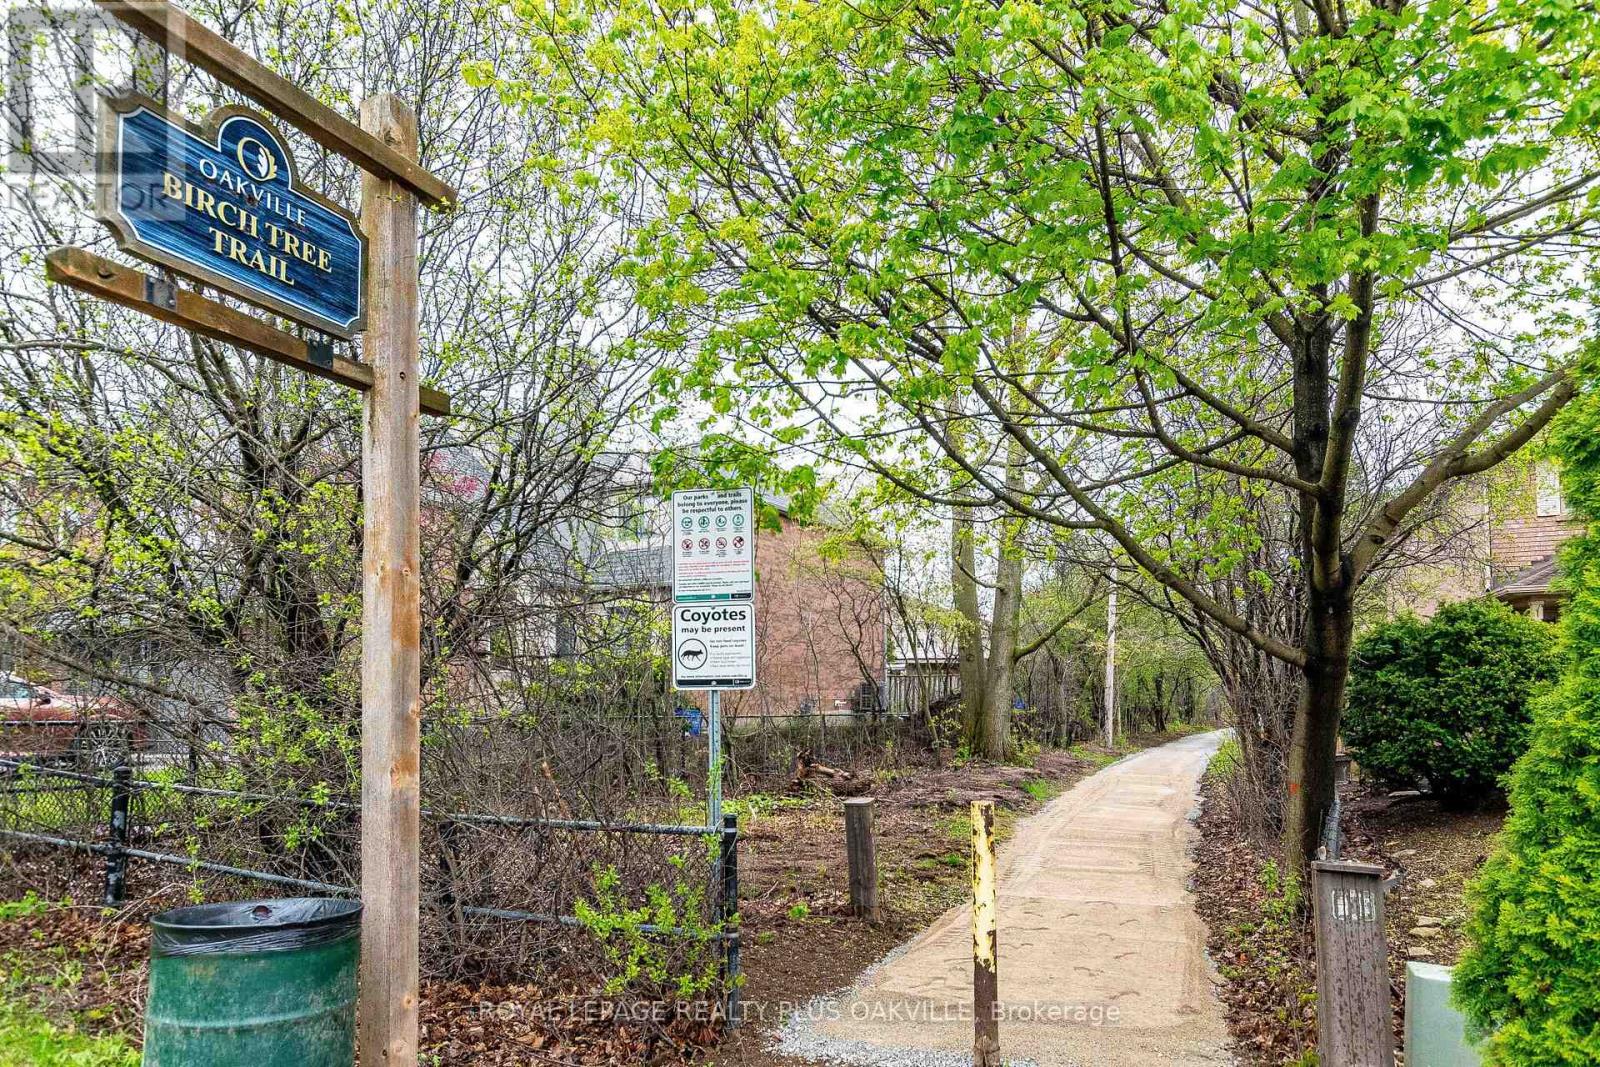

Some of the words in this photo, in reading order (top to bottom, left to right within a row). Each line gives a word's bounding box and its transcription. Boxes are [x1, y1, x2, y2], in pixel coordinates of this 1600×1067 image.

[199, 158, 307, 227] OAKVILLE
[162, 171, 259, 239] BIRCH
[265, 221, 333, 273] TREE
[208, 226, 295, 286] TRAIL
[690, 506, 717, 514] respectful
[680, 608, 746, 625] Coyotes
[681, 627, 699, 635] may
[714, 625, 746, 634] present
